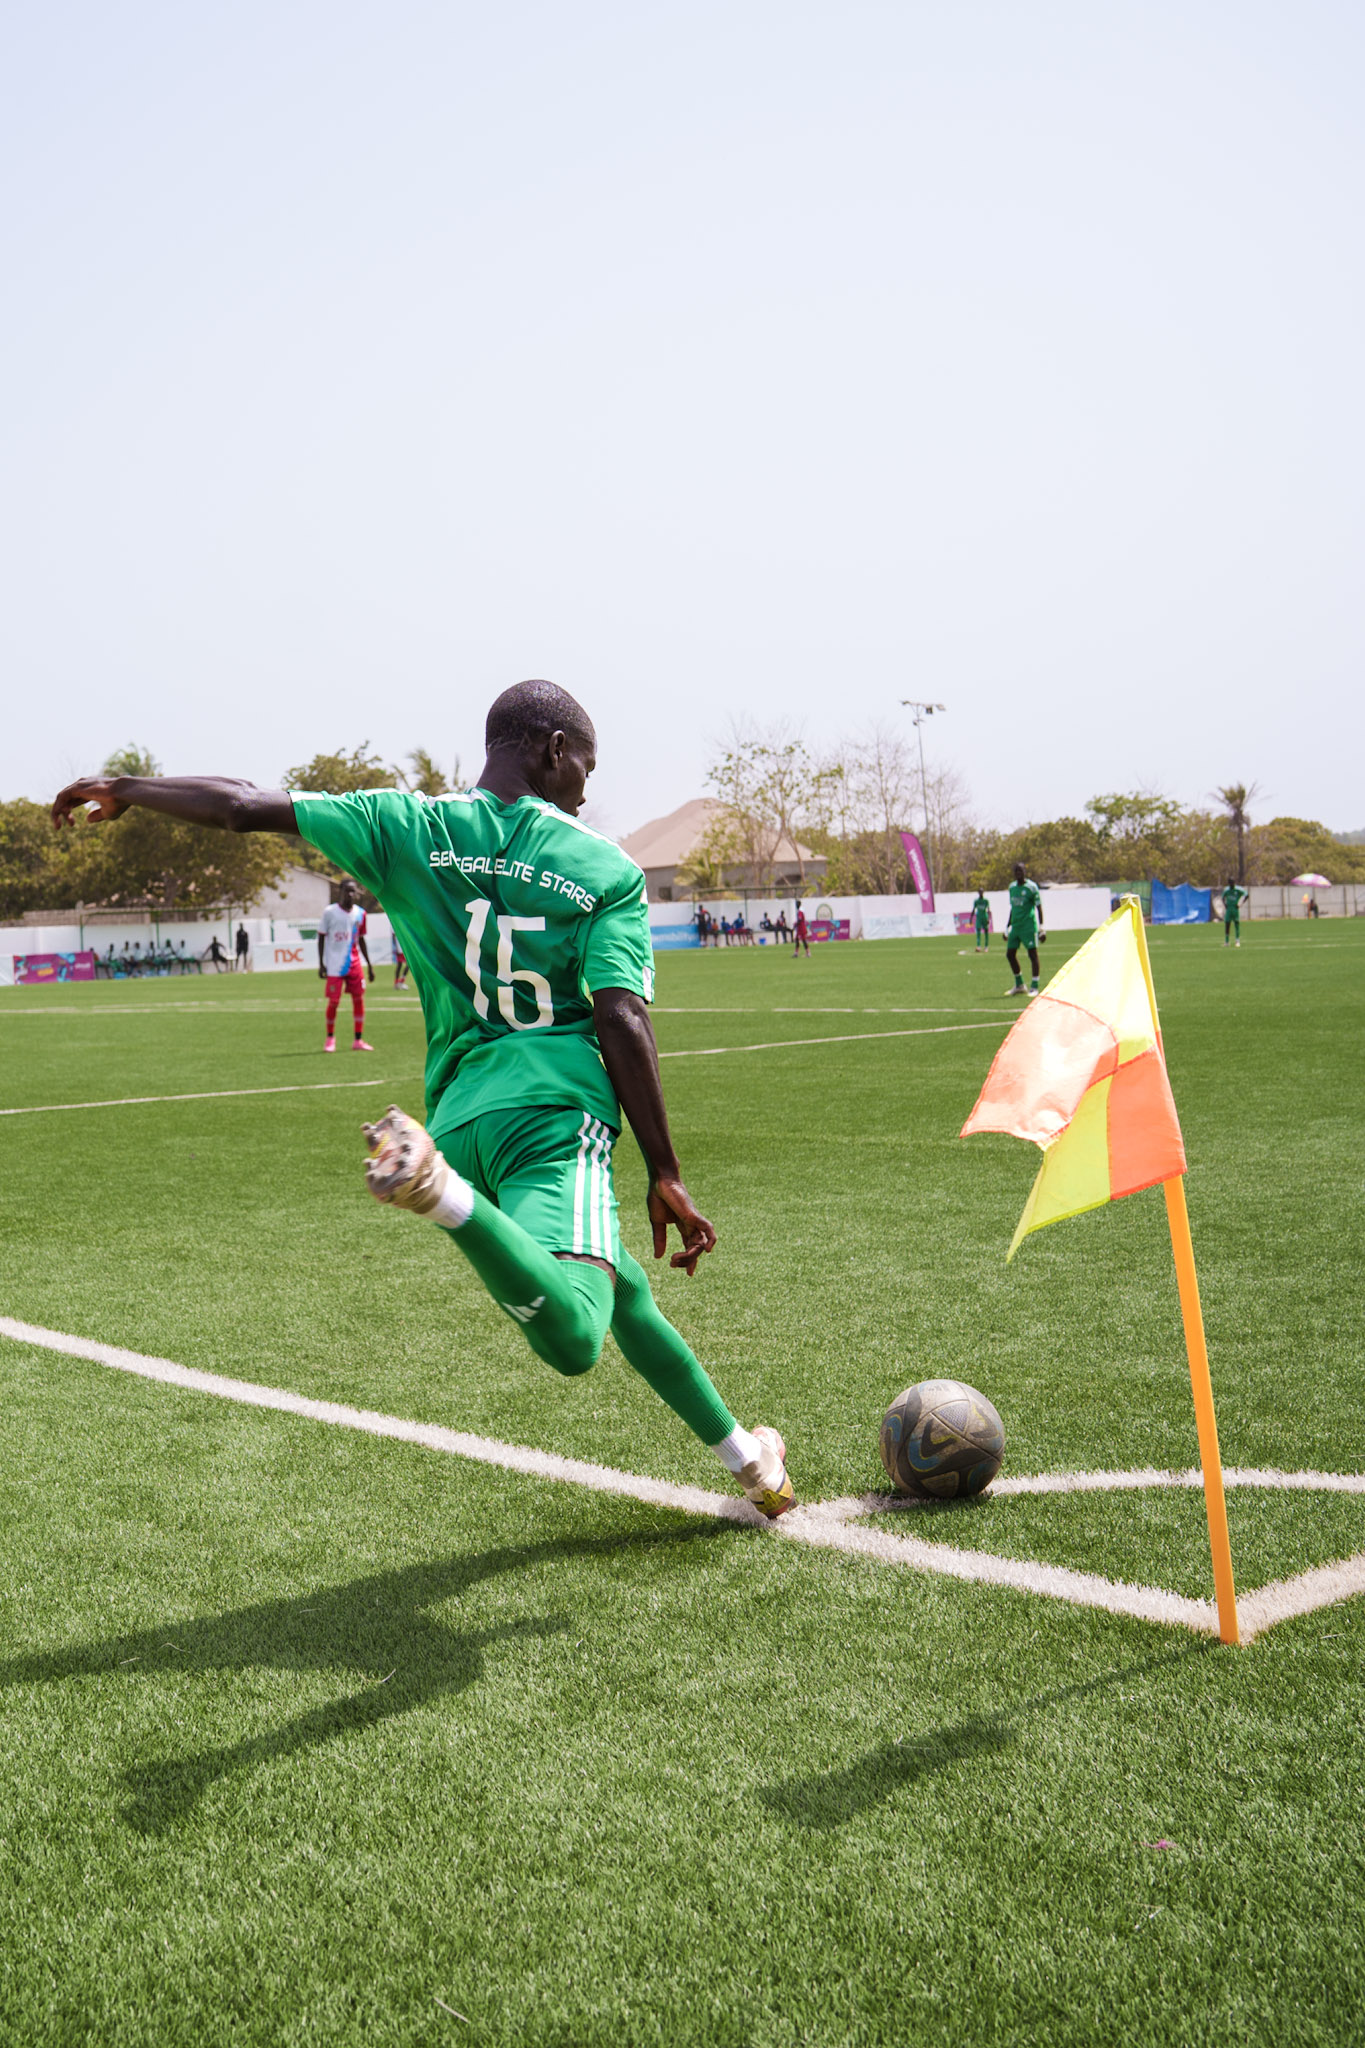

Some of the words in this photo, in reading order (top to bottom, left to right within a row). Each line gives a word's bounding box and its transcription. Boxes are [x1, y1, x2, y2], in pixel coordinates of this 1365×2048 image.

[494, 858, 535, 883] ELITE
[539, 870, 597, 912] STARS
[465, 898, 555, 1031] 15
